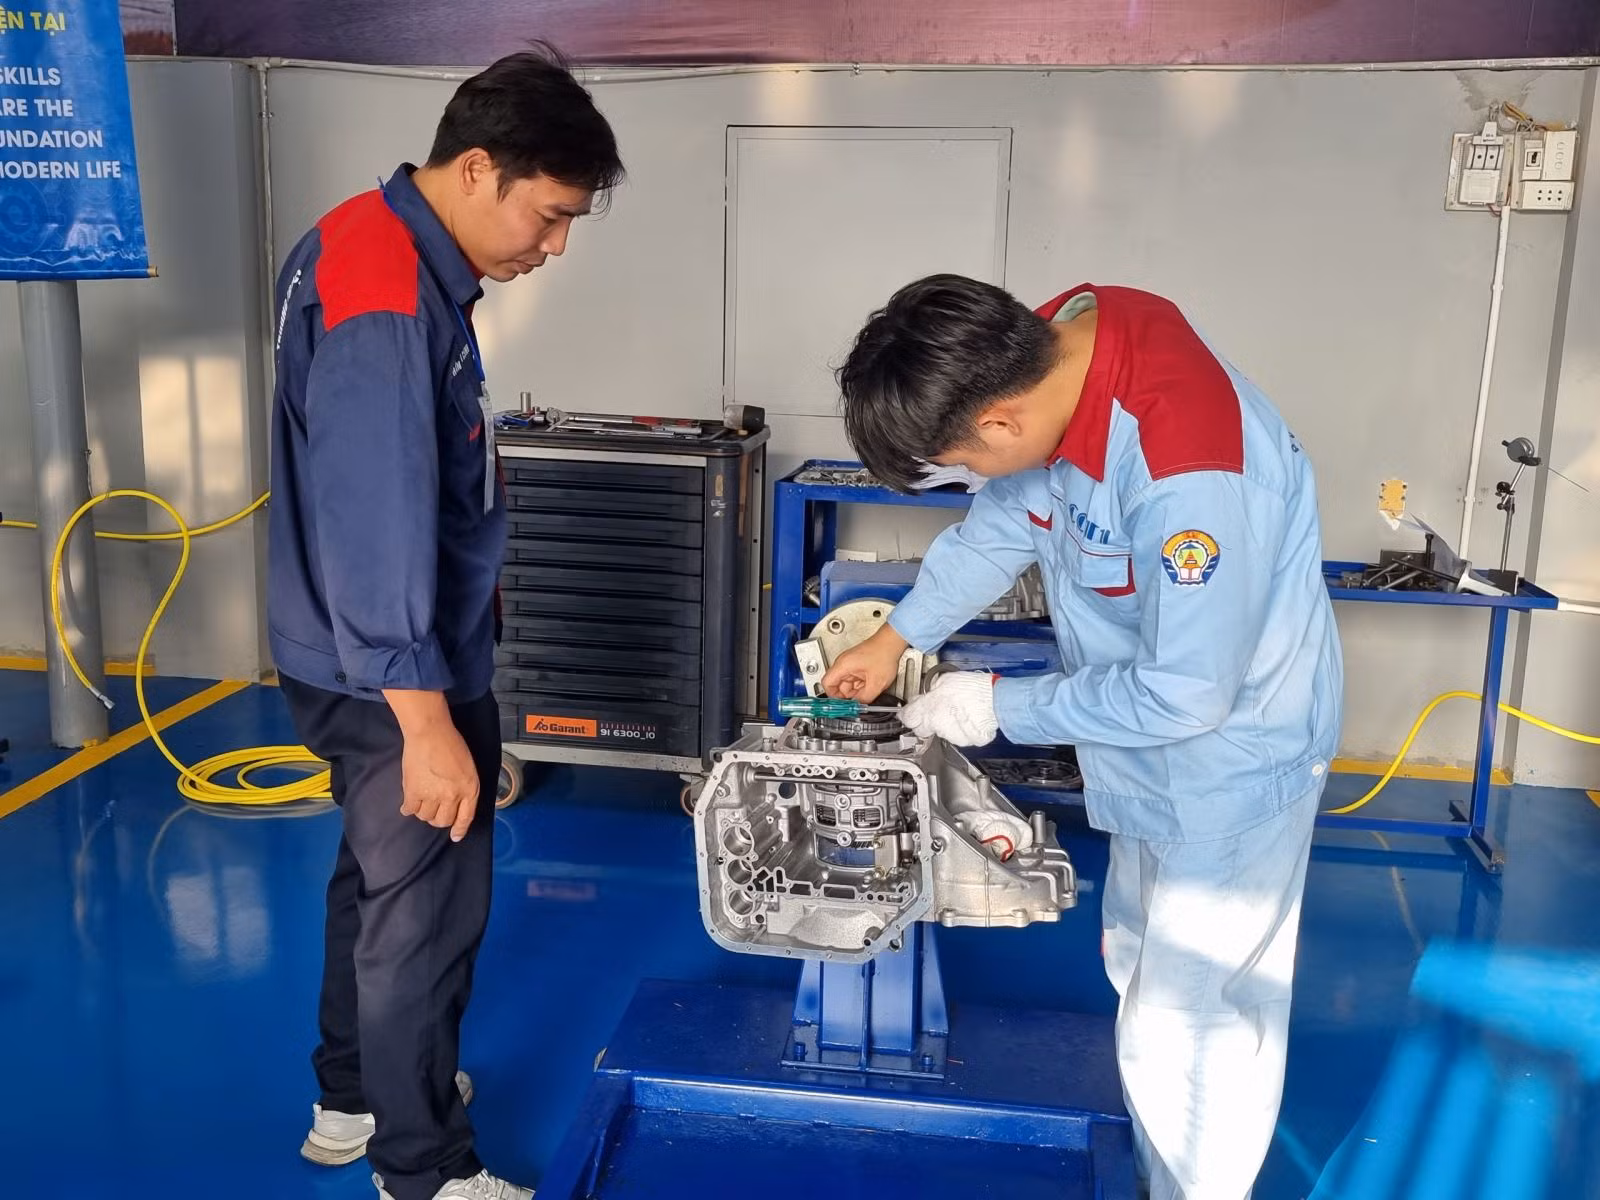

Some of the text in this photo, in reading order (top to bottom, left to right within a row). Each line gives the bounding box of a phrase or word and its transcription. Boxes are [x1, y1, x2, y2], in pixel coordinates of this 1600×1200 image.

[30, 11, 66, 37] TẠI
[0, 98, 74, 118] RE THE
[0, 160, 122, 179] ODERN LIFE
[549, 723, 586, 734] Garant
